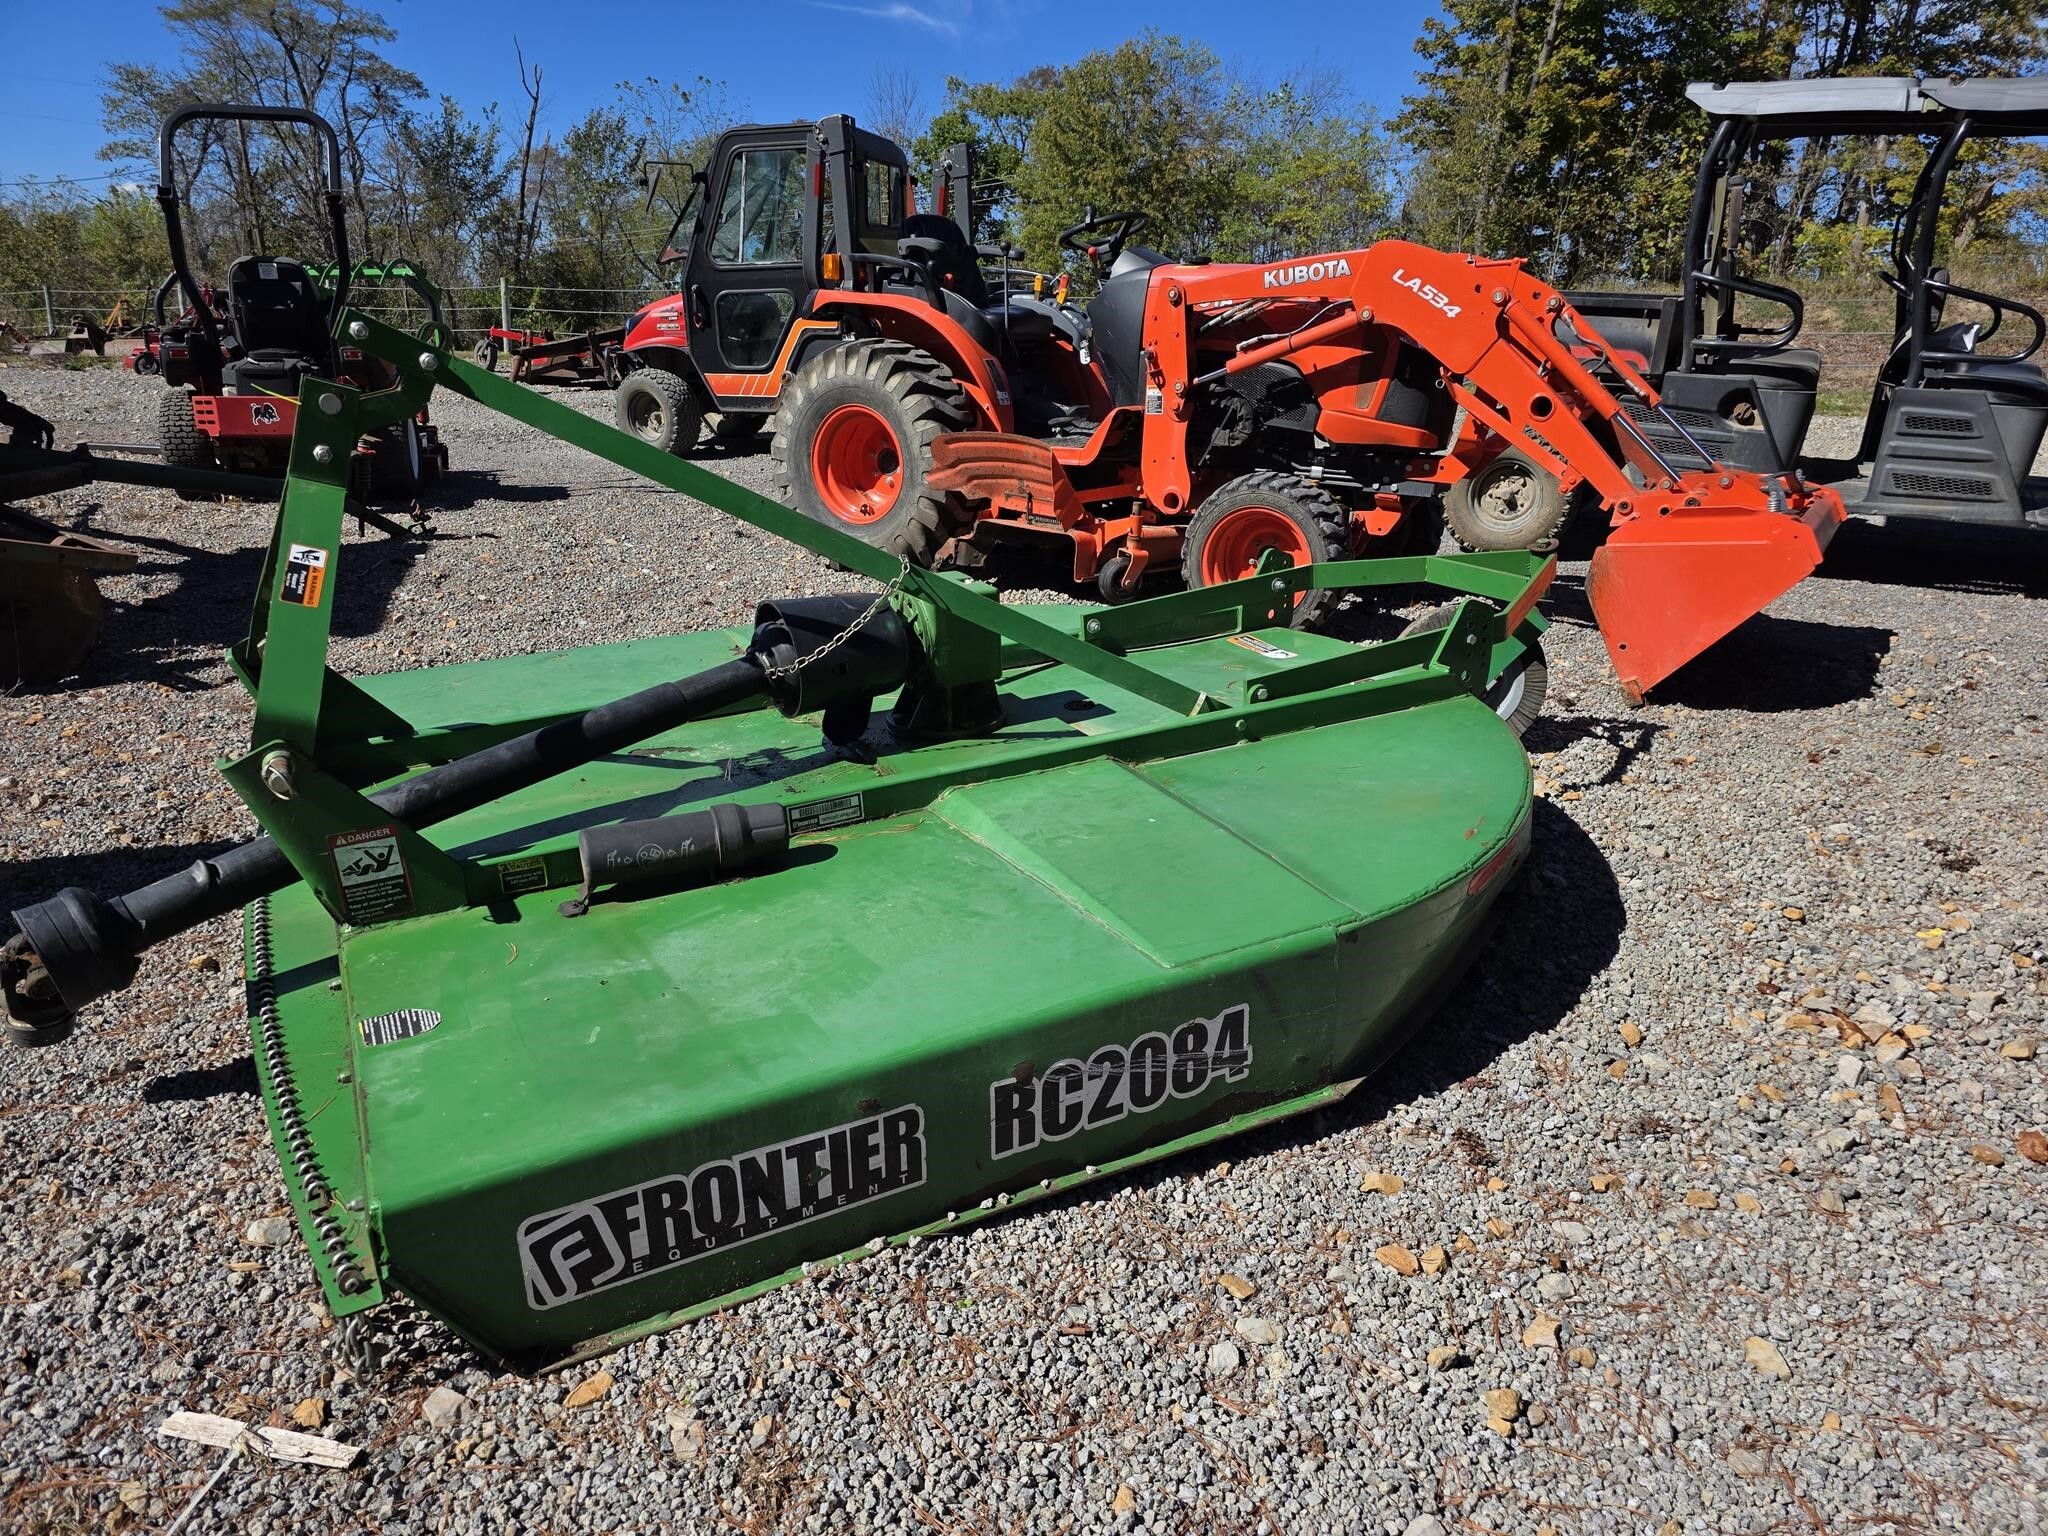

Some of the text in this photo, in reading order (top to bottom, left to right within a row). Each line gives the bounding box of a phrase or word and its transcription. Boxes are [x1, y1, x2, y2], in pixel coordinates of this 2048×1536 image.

[1264, 258, 1352, 289] KUBOTA
[1392, 268, 1462, 318] LA534
[307, 575, 318, 604] WARNING
[347, 827, 391, 843] DANGER
[992, 1005, 1251, 1158] RC2084
[594, 1106, 924, 1282] FRONTIER
[632, 1174, 907, 1274] EQUIPMENT
